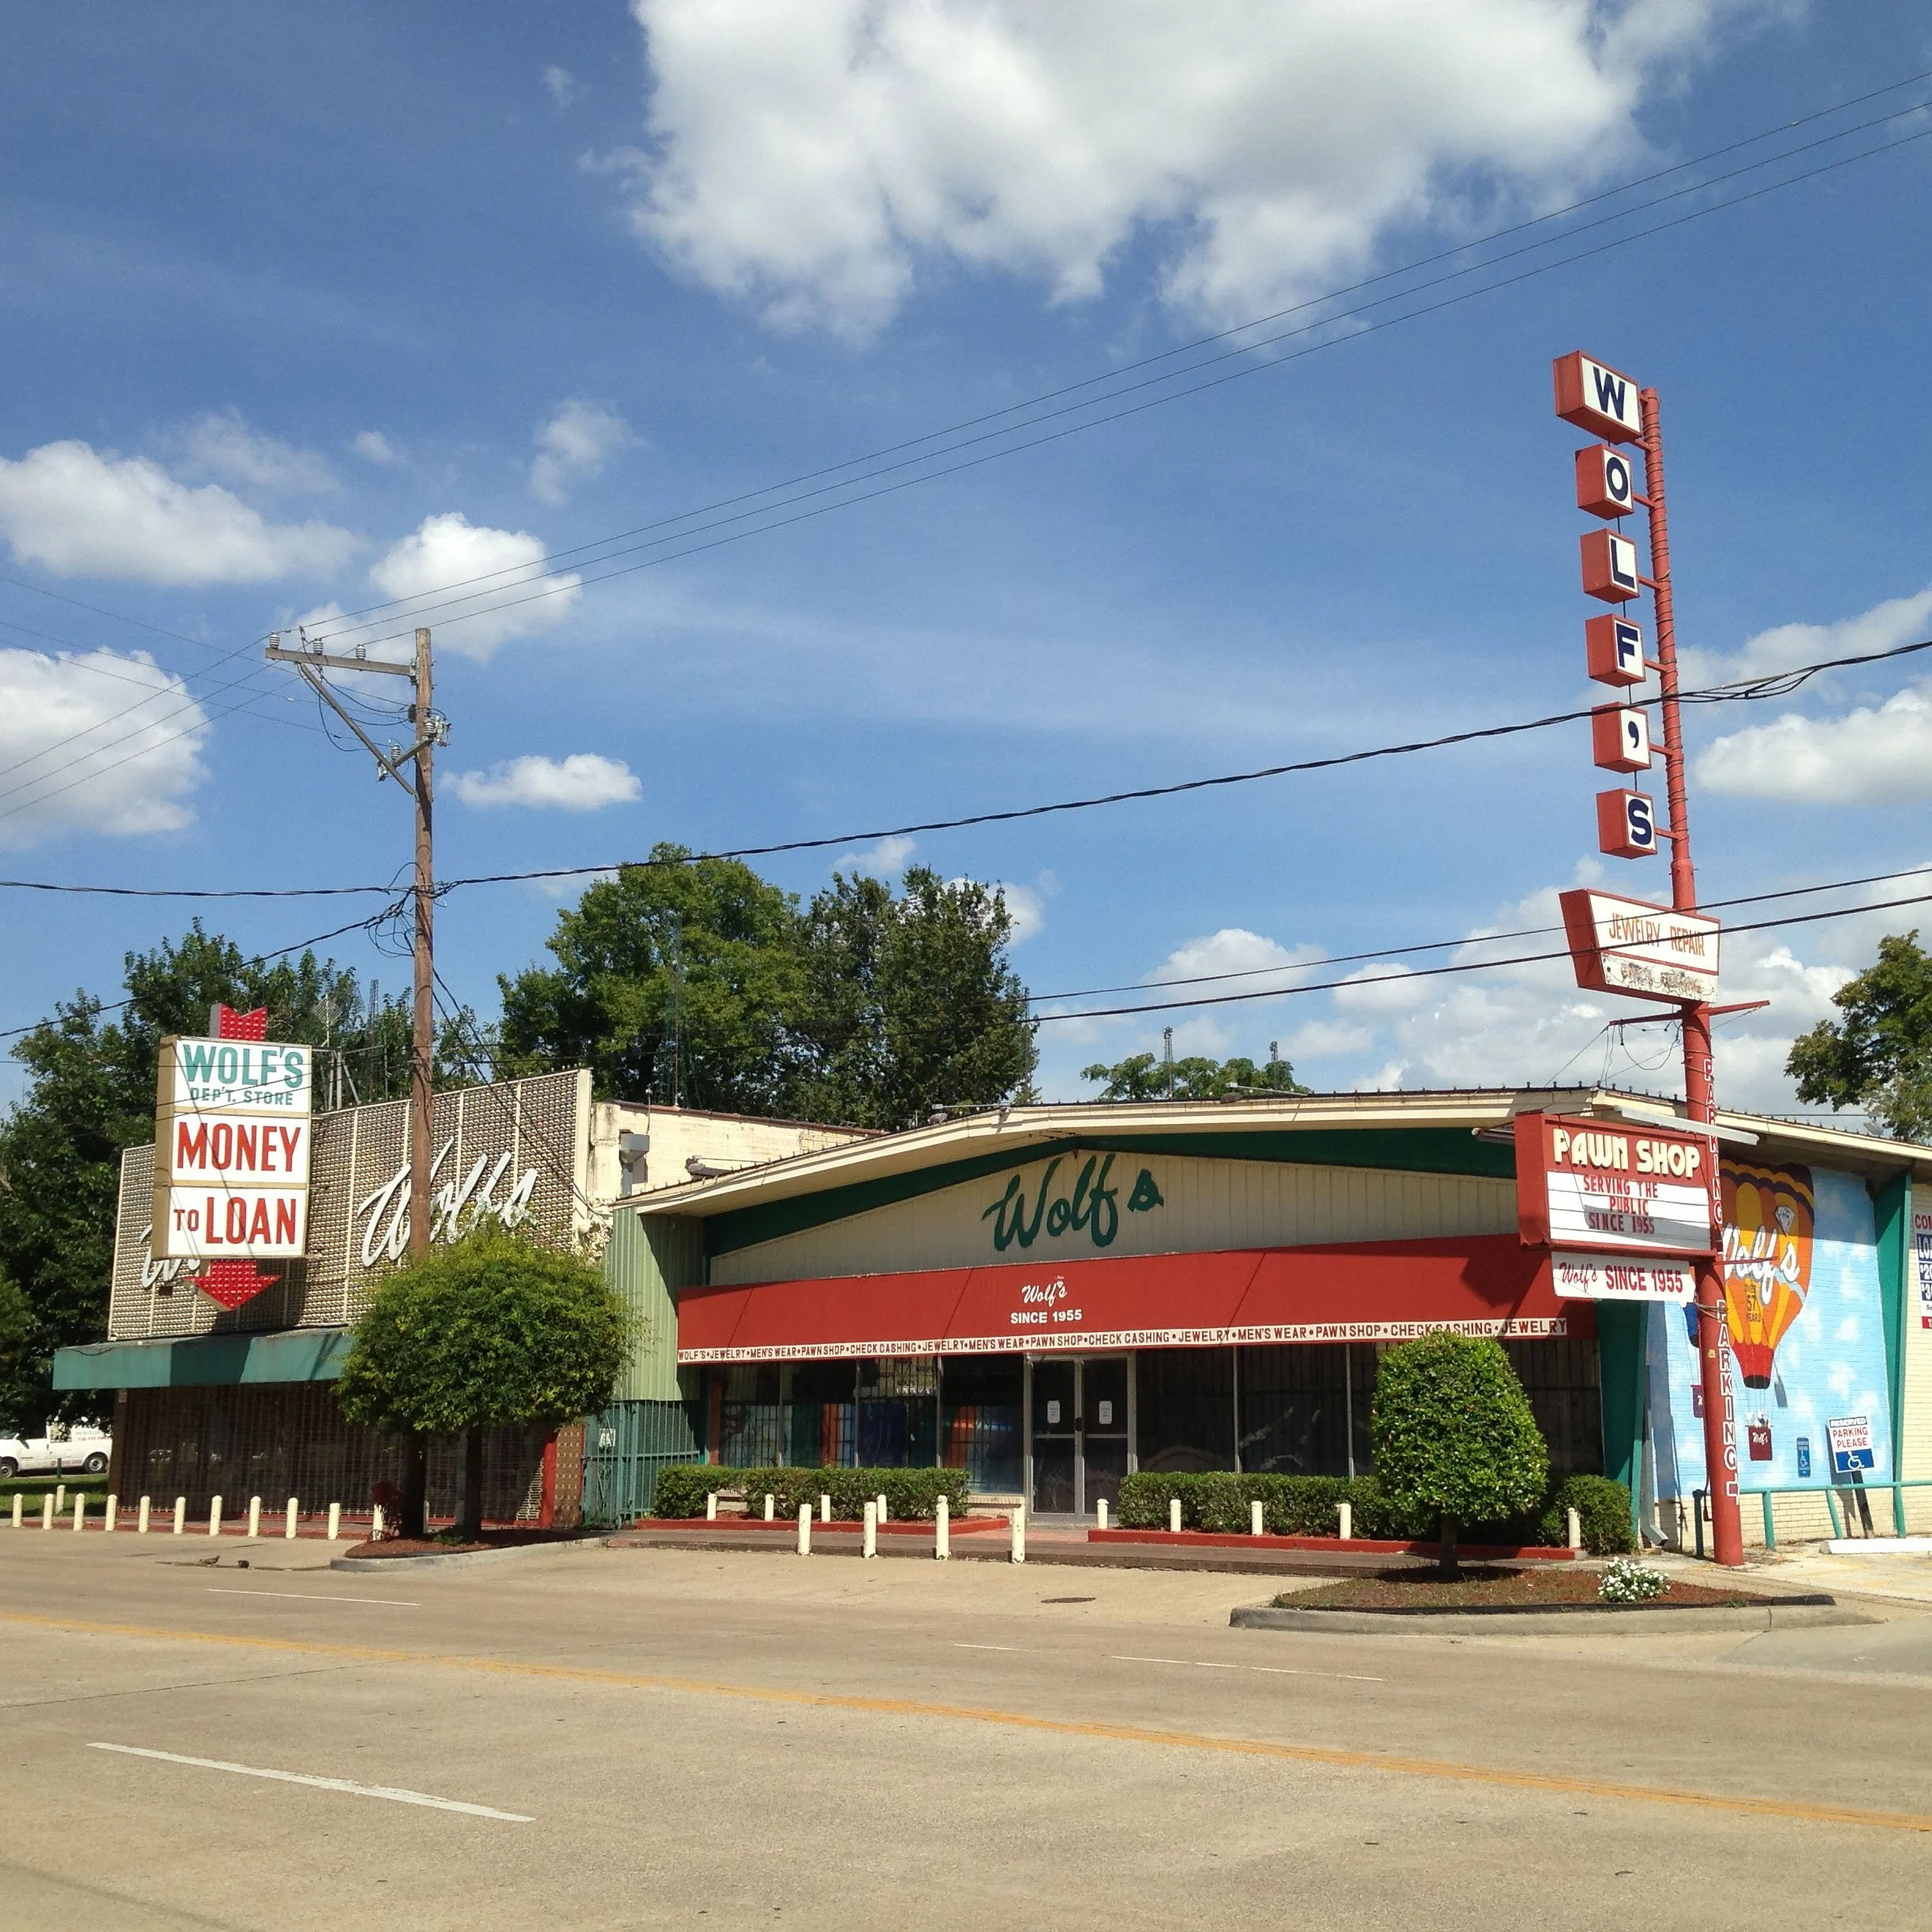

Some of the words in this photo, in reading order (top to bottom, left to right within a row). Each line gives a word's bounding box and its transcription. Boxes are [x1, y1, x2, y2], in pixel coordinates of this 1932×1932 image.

[1593, 365, 1653, 845] WOLF'S
[1608, 912, 1661, 947] JEWELRY
[1670, 926, 1705, 957] REPAIR
[182, 1044, 304, 1088] WOLF'S
[244, 1090, 293, 1106] STORE
[177, 1121, 301, 1172] MONEY
[1553, 1129, 1629, 1170] PAWN
[1636, 1140, 1701, 1178] SHOP
[1583, 1174, 1631, 1196] SERVING
[1638, 1181, 1658, 1198] THE
[174, 1209, 199, 1231] TO
[206, 1196, 297, 1245] LOAN
[1610, 1196, 1649, 1216] PUBLIC
[1588, 1212, 1624, 1232] SINCE
[1631, 1215, 1655, 1234] 1955
[1558, 1262, 1598, 1293] Wolf's
[1605, 1265, 1647, 1291] SINCE
[1651, 1269, 1683, 1294] 1955
[1010, 1312, 1047, 1324] SINCE
[1052, 1309, 1083, 1322] 1955
[1747, 1294, 1757, 1311] 57
[679, 1350, 706, 1361] WOLF'S
[710, 1349, 746, 1360] JEWELRY
[751, 1347, 773, 1358] MEN'S
[775, 1347, 796, 1357] WEAR
[801, 1346, 822, 1357] PAWN
[823, 1344, 845, 1355] SHOP
[850, 1342, 878, 1354] CHECK
[880, 1341, 916, 1353] CASHING
[923, 1339, 964, 1352] JEWELRY
[968, 1339, 996, 1350] MEN'S
[998, 1337, 1024, 1349] WEAR
[1030, 1336, 1055, 1348] PAWN
[1057, 1335, 1084, 1346] SHOP
[1089, 1332, 1122, 1346] CHECK
[1125, 1331, 1170, 1345] CASHING
[1178, 1329, 1230, 1342] JEWELRY
[1238, 1327, 1271, 1341] MEN'S
[1274, 1327, 1307, 1339] WEAR
[1316, 1325, 1346, 1339] PAWN
[1350, 1324, 1381, 1337] SHOP
[1391, 1324, 1432, 1336] CHECK
[1501, 1320, 1567, 1334] JEWELRY
[1716, 1299, 1737, 1470] PARKING
[1833, 1427, 1868, 1438] PARKING
[1837, 1438, 1868, 1448] PLEASE
